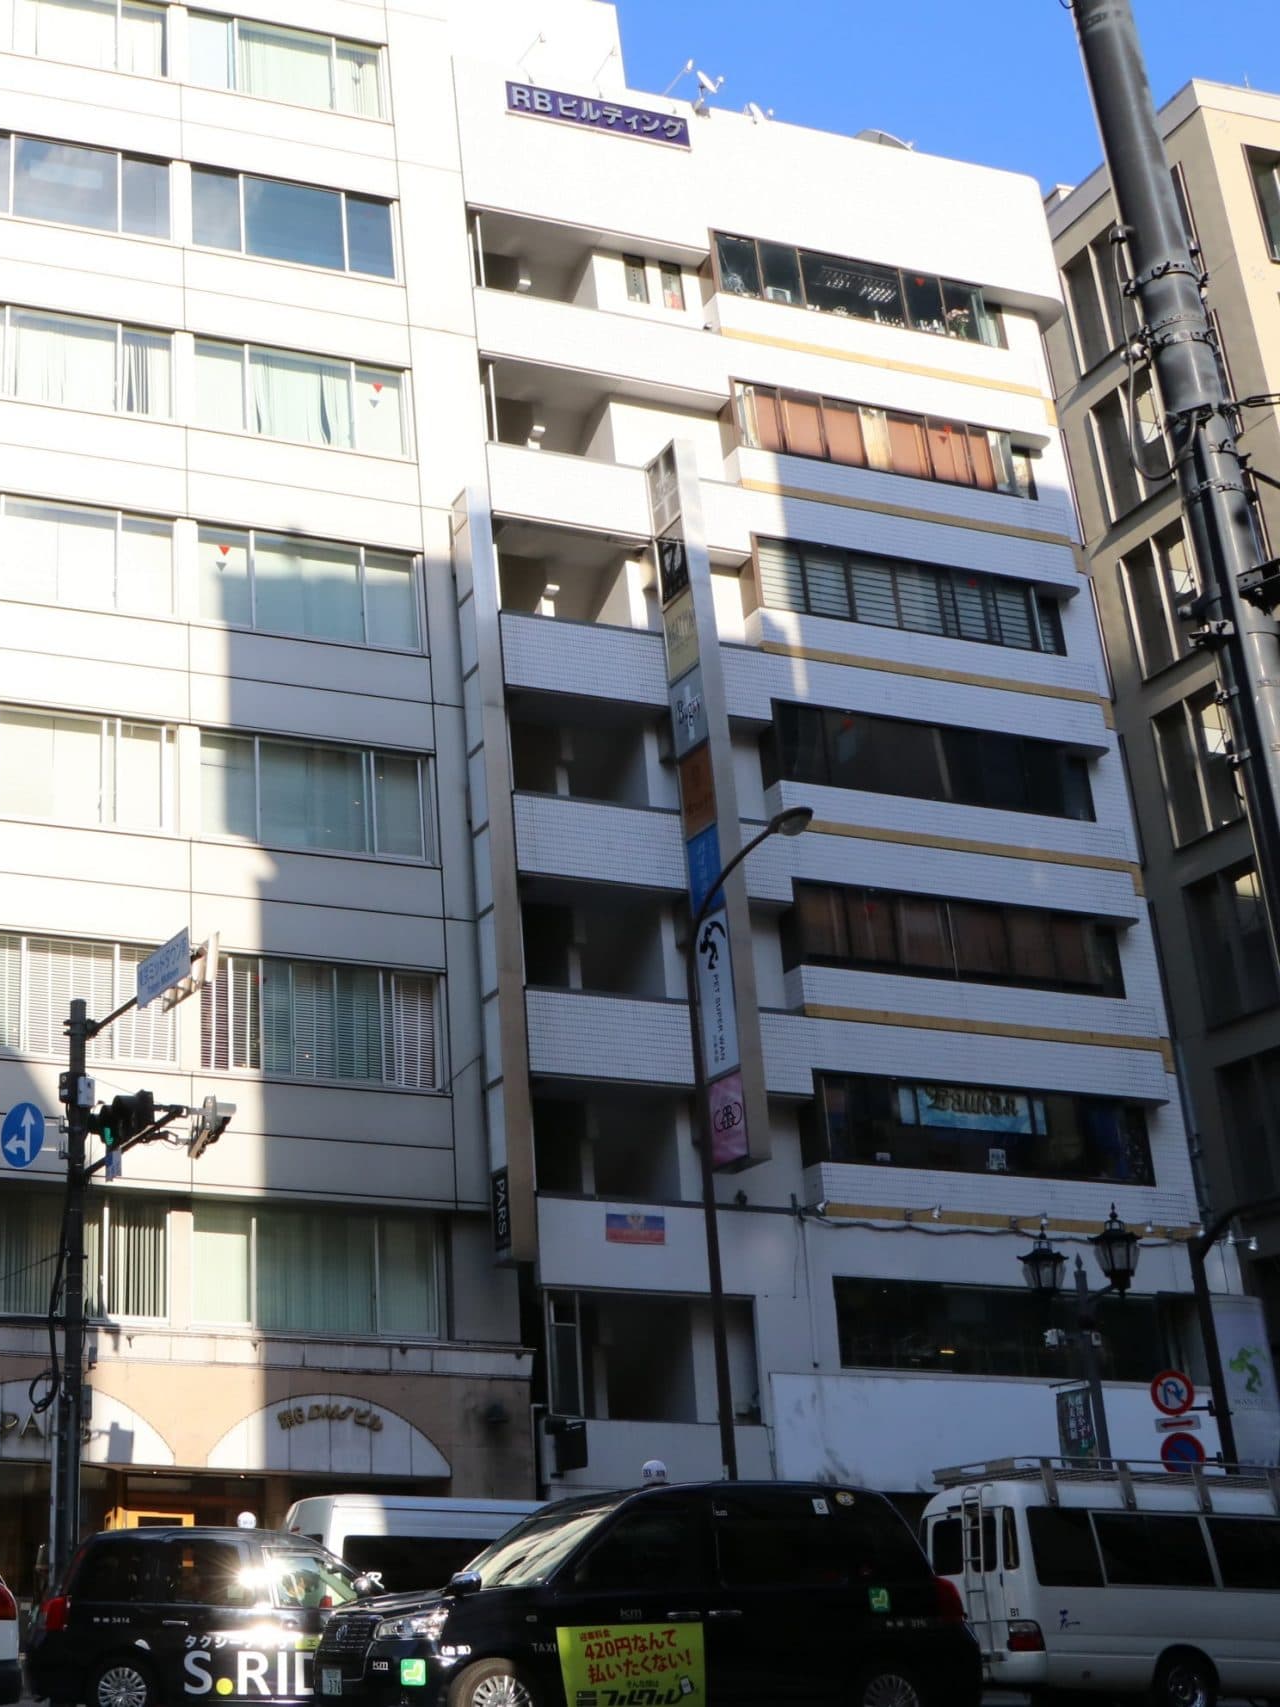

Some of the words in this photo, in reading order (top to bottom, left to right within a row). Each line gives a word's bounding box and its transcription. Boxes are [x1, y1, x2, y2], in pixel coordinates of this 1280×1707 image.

[496, 1177, 508, 1236] PARS
[530, 1642, 556, 1653] TAXI
[584, 1628, 677, 1661] 420円なんて
[372, 1660, 389, 1671] km
